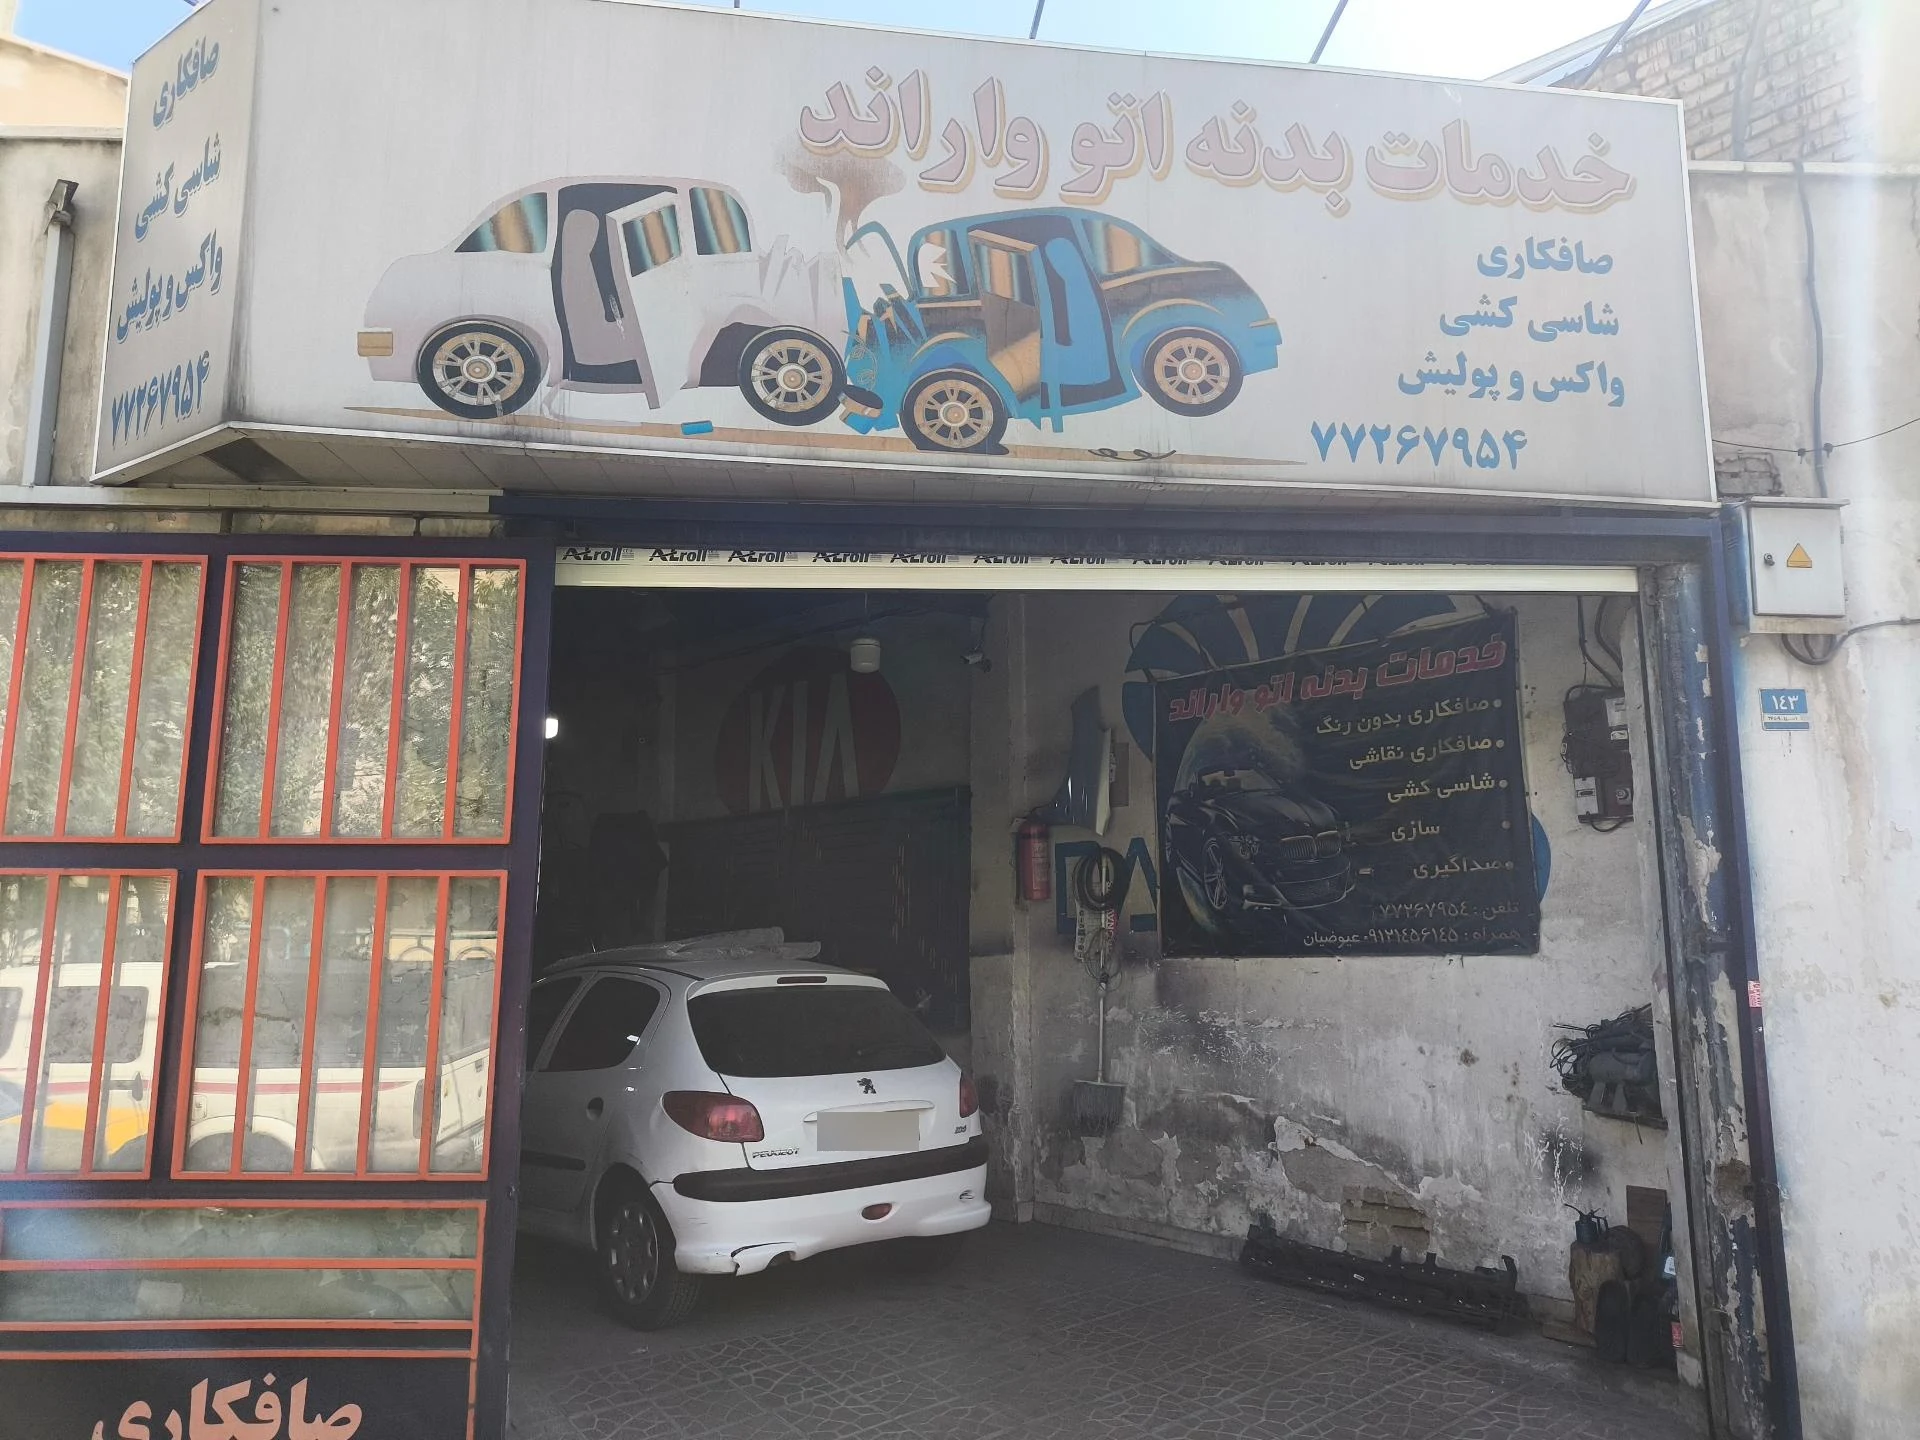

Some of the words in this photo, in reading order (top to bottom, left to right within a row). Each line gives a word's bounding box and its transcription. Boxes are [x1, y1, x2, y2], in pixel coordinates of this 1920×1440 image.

[153, 36, 220, 129] صافکاری
[1059, 90, 1174, 205] اتو
[1184, 98, 1353, 217] بدنه
[1366, 117, 1636, 214] خدمات
[174, 132, 221, 218] شاسی
[135, 162, 176, 242] کشی
[176, 228, 223, 313] واکس
[1477, 236, 1613, 279] صافکاری
[116, 267, 163, 345] پولیش
[163, 271, 175, 318] و
[1440, 294, 1517, 336] کشی
[1528, 301, 1619, 342] شاسی
[1398, 351, 1498, 401] پولیش
[1507, 370, 1524, 401] و
[1533, 360, 1624, 407] واکس
[110, 350, 211, 451] ۷۷۲۶۷۹۵۴
[1310, 420, 1527, 470] ۷۷۲۶۷۹۵۴
[1300, 664, 1368, 700] بدنه
[1376, 633, 1506, 687] خدمات
[1255, 671, 1295, 713] اتو
[1408, 697, 1489, 725] صافکاری
[747, 672, 862, 815] KIA
[1316, 715, 1351, 736] رنگ
[1357, 713, 1402, 733] بدون
[1350, 746, 1404, 770] نقاشی
[1410, 735, 1492, 763] صافکاری
[1387, 779, 1433, 803] کشی
[1437, 772, 1495, 798] شاسی
[1391, 820, 1440, 842] سازی
[1413, 855, 1501, 880] صداگیری
